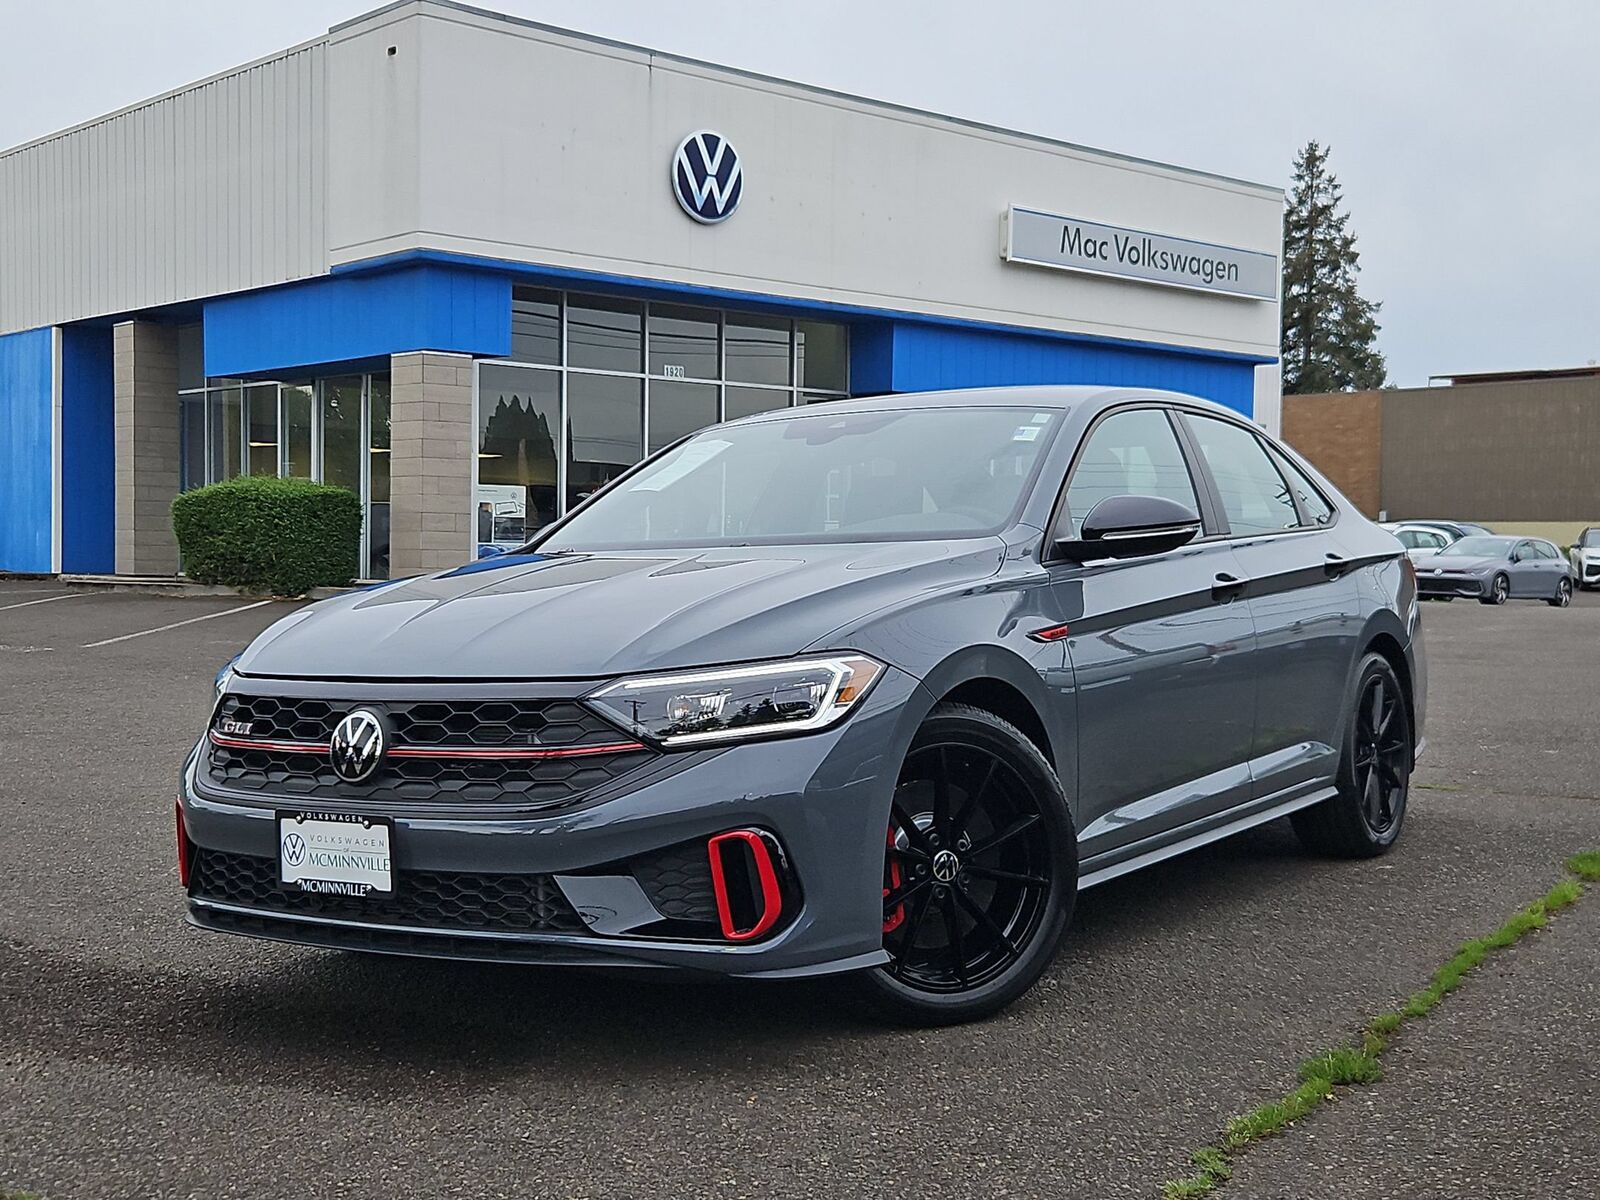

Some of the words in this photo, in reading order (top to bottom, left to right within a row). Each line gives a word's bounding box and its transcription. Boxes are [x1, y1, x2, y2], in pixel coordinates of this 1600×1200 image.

[674, 131, 743, 222] VW
[1060, 225, 1109, 261] Mac
[1114, 234, 1239, 285] Volkswagen
[665, 366, 684, 378] 1920
[224, 721, 254, 735] GLI
[300, 812, 363, 823] VOLKSWAGEN
[309, 834, 385, 847] VOLKSWAGEN
[308, 853, 391, 872] MCMINNVILLE
[301, 880, 367, 897] MCMINNVILLE
